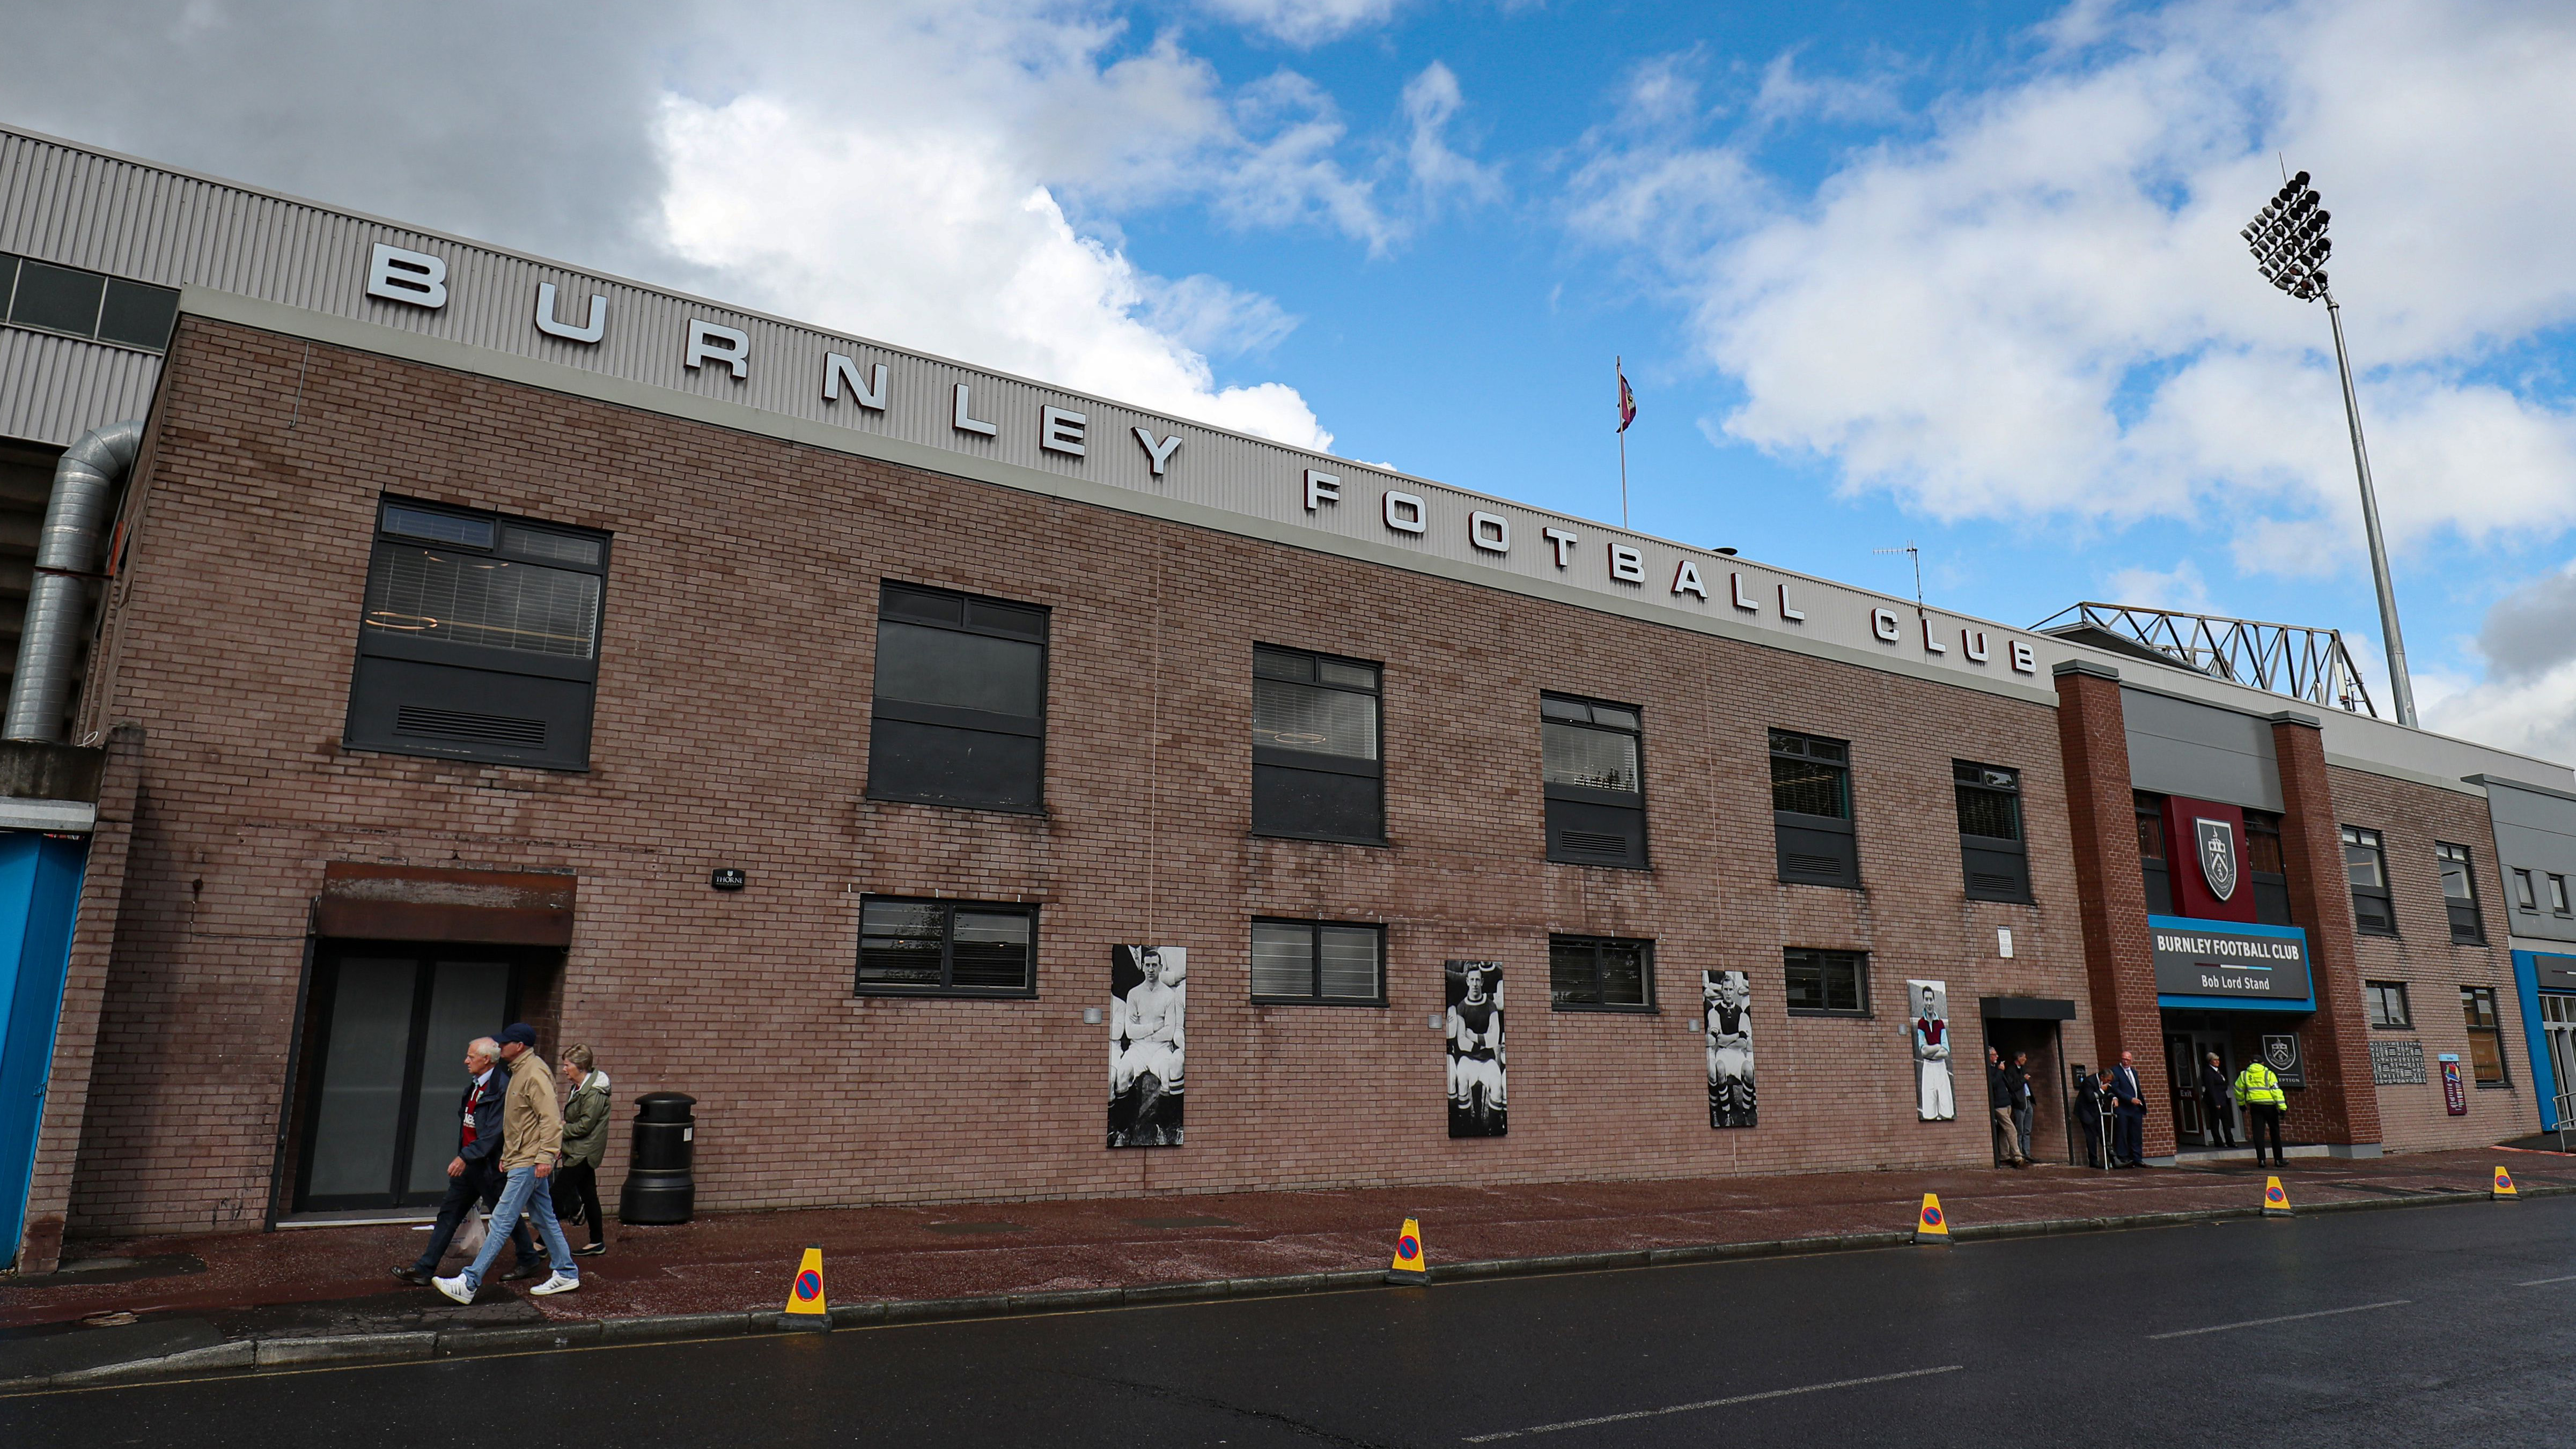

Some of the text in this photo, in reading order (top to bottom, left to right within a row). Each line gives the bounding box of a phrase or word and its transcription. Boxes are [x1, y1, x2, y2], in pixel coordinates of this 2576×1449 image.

[366, 242, 2037, 673] BURNLEY FOOTBALL CLUB
[2157, 935, 2299, 960] BURNLEY FOOTBALL CLUB
[2201, 974, 2270, 990] Bob Lord Stand
[2180, 1089, 2192, 1097] Exit
